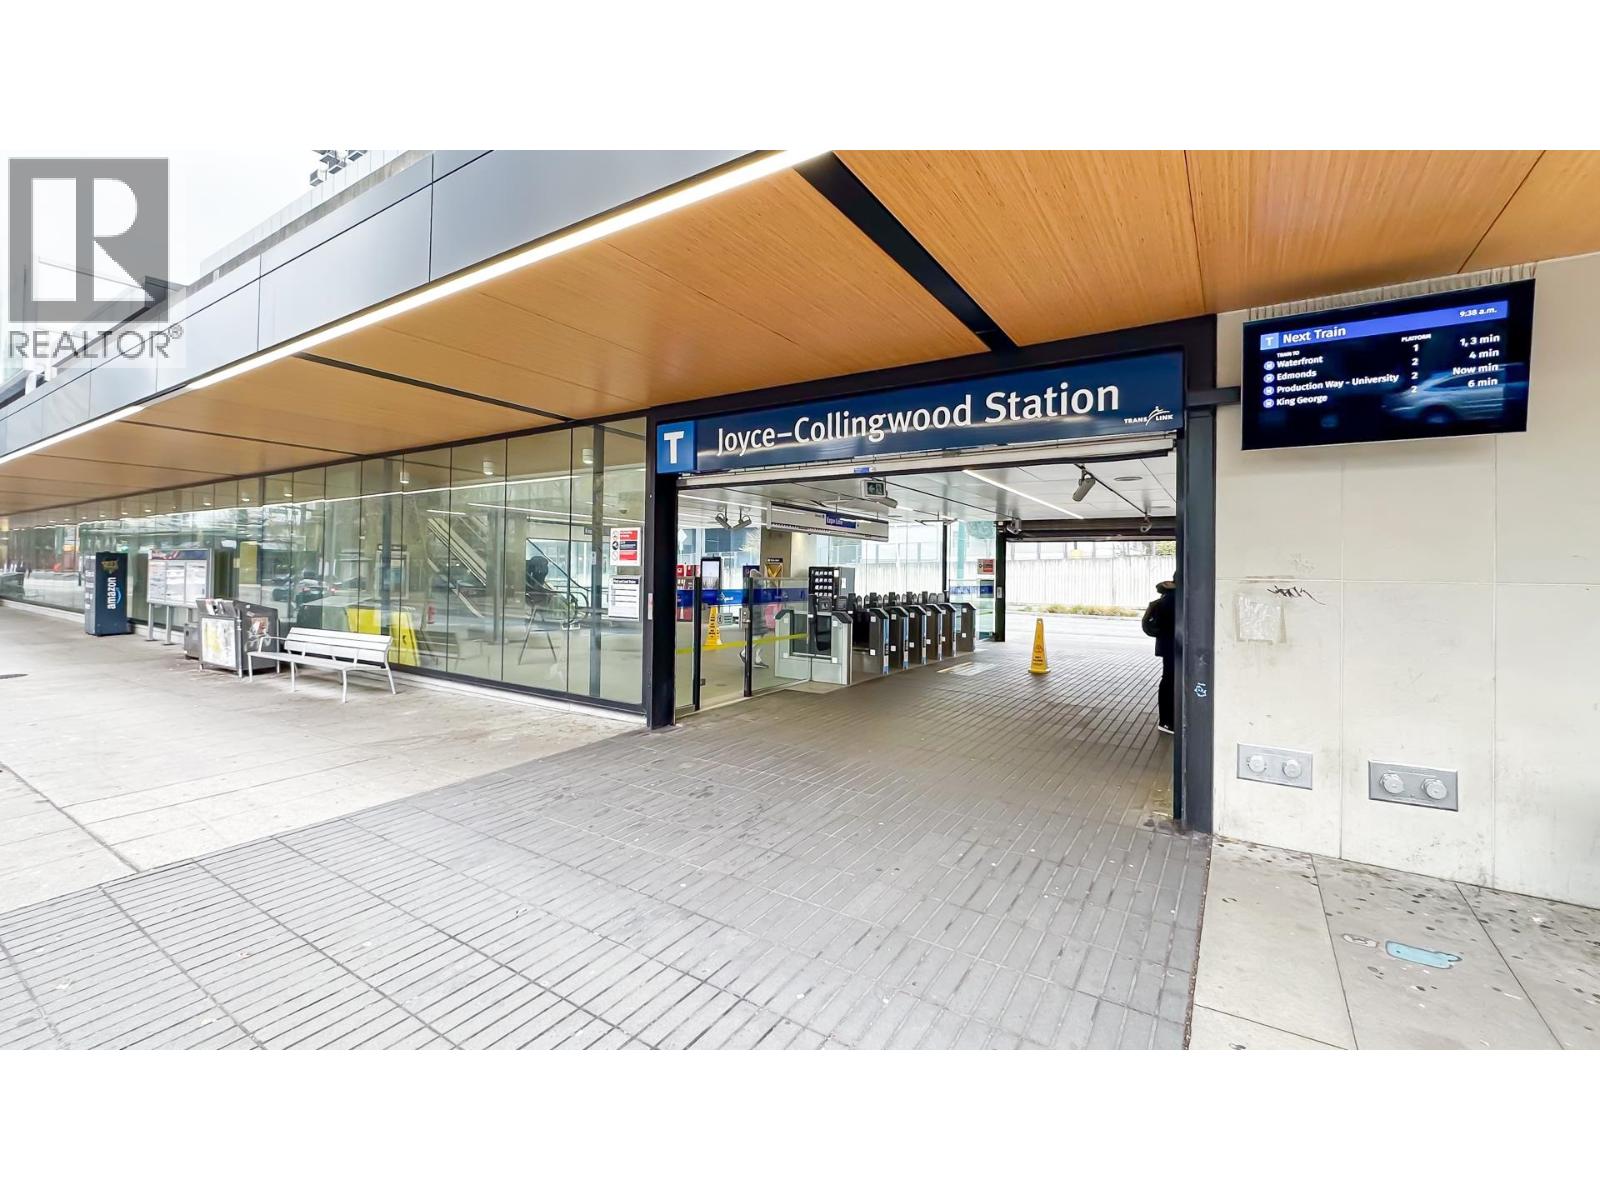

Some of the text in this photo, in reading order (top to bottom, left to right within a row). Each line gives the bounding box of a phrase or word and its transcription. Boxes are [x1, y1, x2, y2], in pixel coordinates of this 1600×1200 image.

[1460, 309, 1477, 317] 9:38
[1283, 327, 1346, 344] Next Train
[1460, 334, 1500, 347] 1, 3 min
[1413, 344, 1419, 352] 1
[1469, 348, 1500, 359] 4 min
[1276, 356, 1324, 368] Waterfront
[1411, 358, 1419, 366] 2
[1276, 369, 1317, 381] Edmonds
[1452, 363, 1499, 375] Now min
[1411, 371, 1418, 380] 2
[1276, 382, 1324, 394] Production
[1325, 381, 1344, 389] Way
[1351, 374, 1400, 386] University
[1467, 377, 1498, 388] 6 min
[1411, 385, 1418, 393] 2
[984, 381, 1120, 424] Station
[1276, 395, 1328, 406] King George
[663, 430, 685, 465] T
[106, 577, 117, 610] amazon
